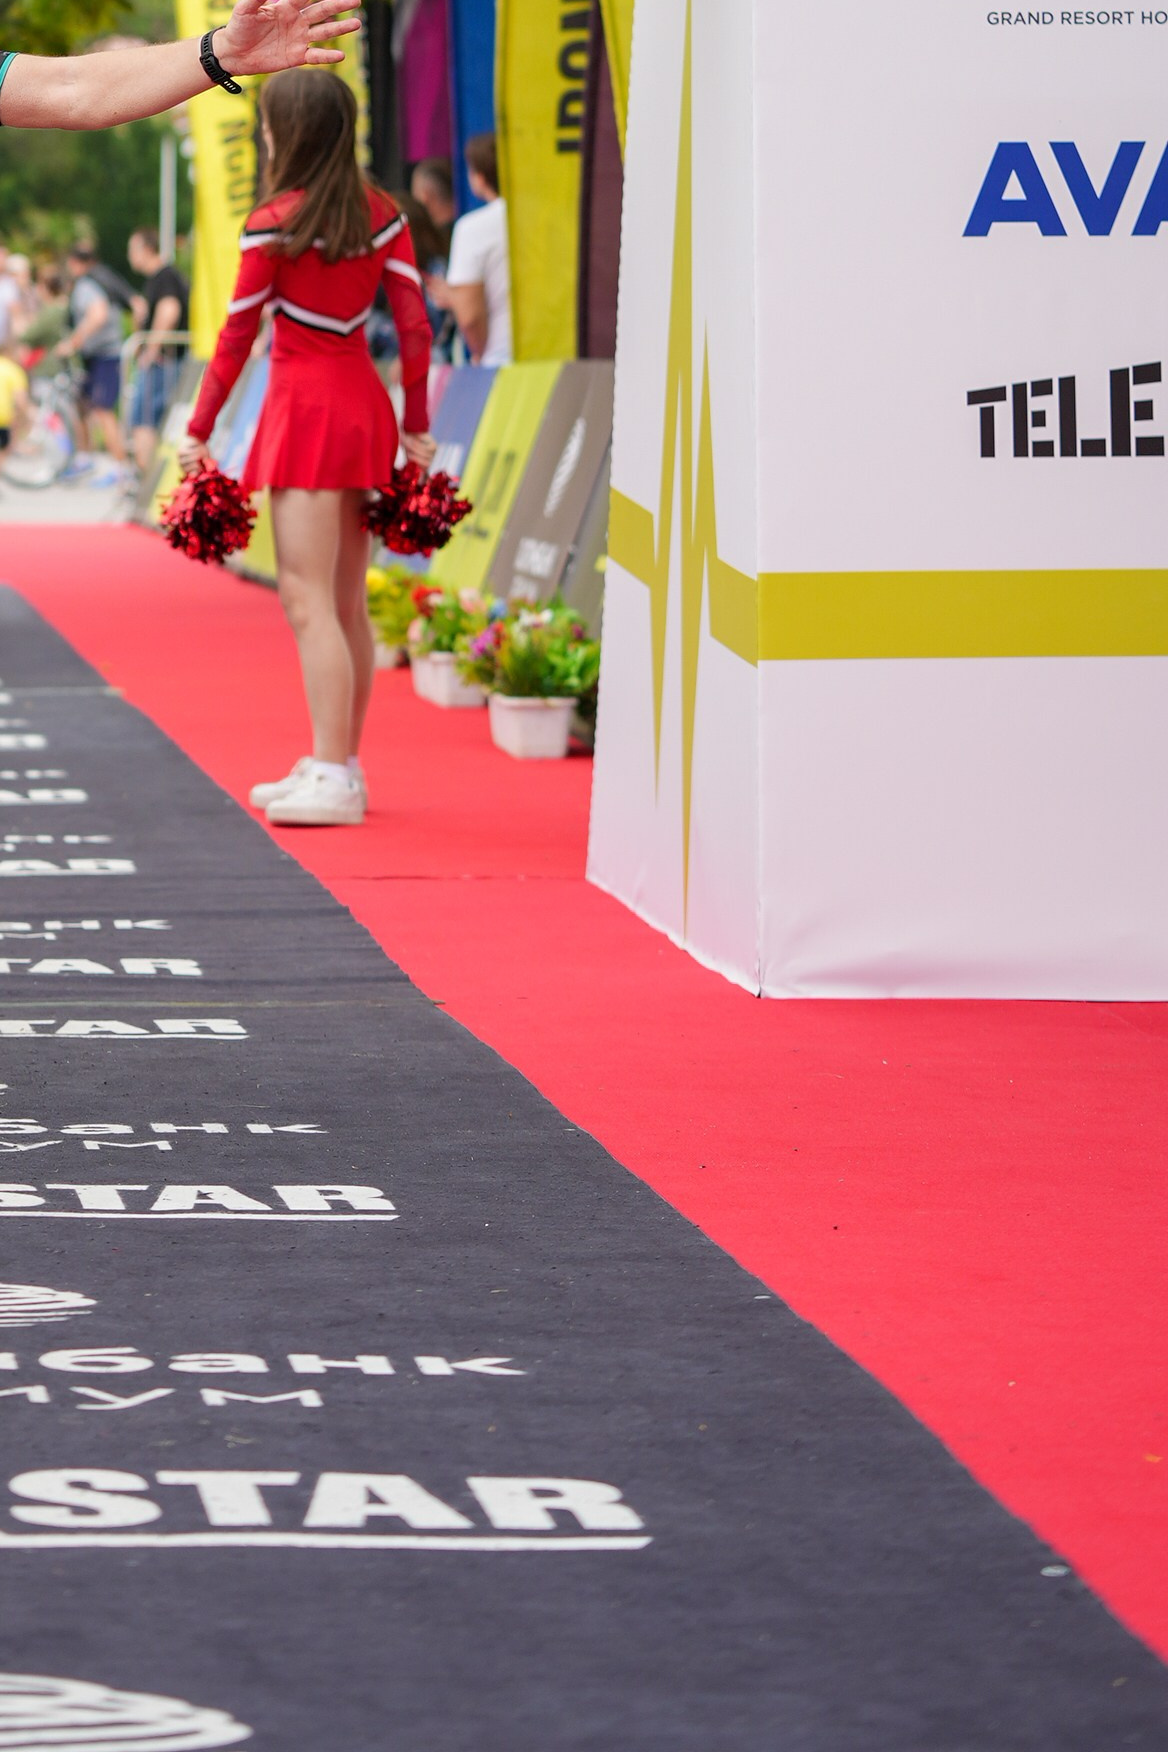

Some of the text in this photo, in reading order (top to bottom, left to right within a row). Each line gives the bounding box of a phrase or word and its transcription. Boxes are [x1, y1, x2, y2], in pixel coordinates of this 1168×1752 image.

[987, 11, 1054, 25] GRAND
[1061, 11, 1135, 25] RESORT
[966, 361, 1165, 458] TELE
[8, 1468, 646, 1531] STAR
